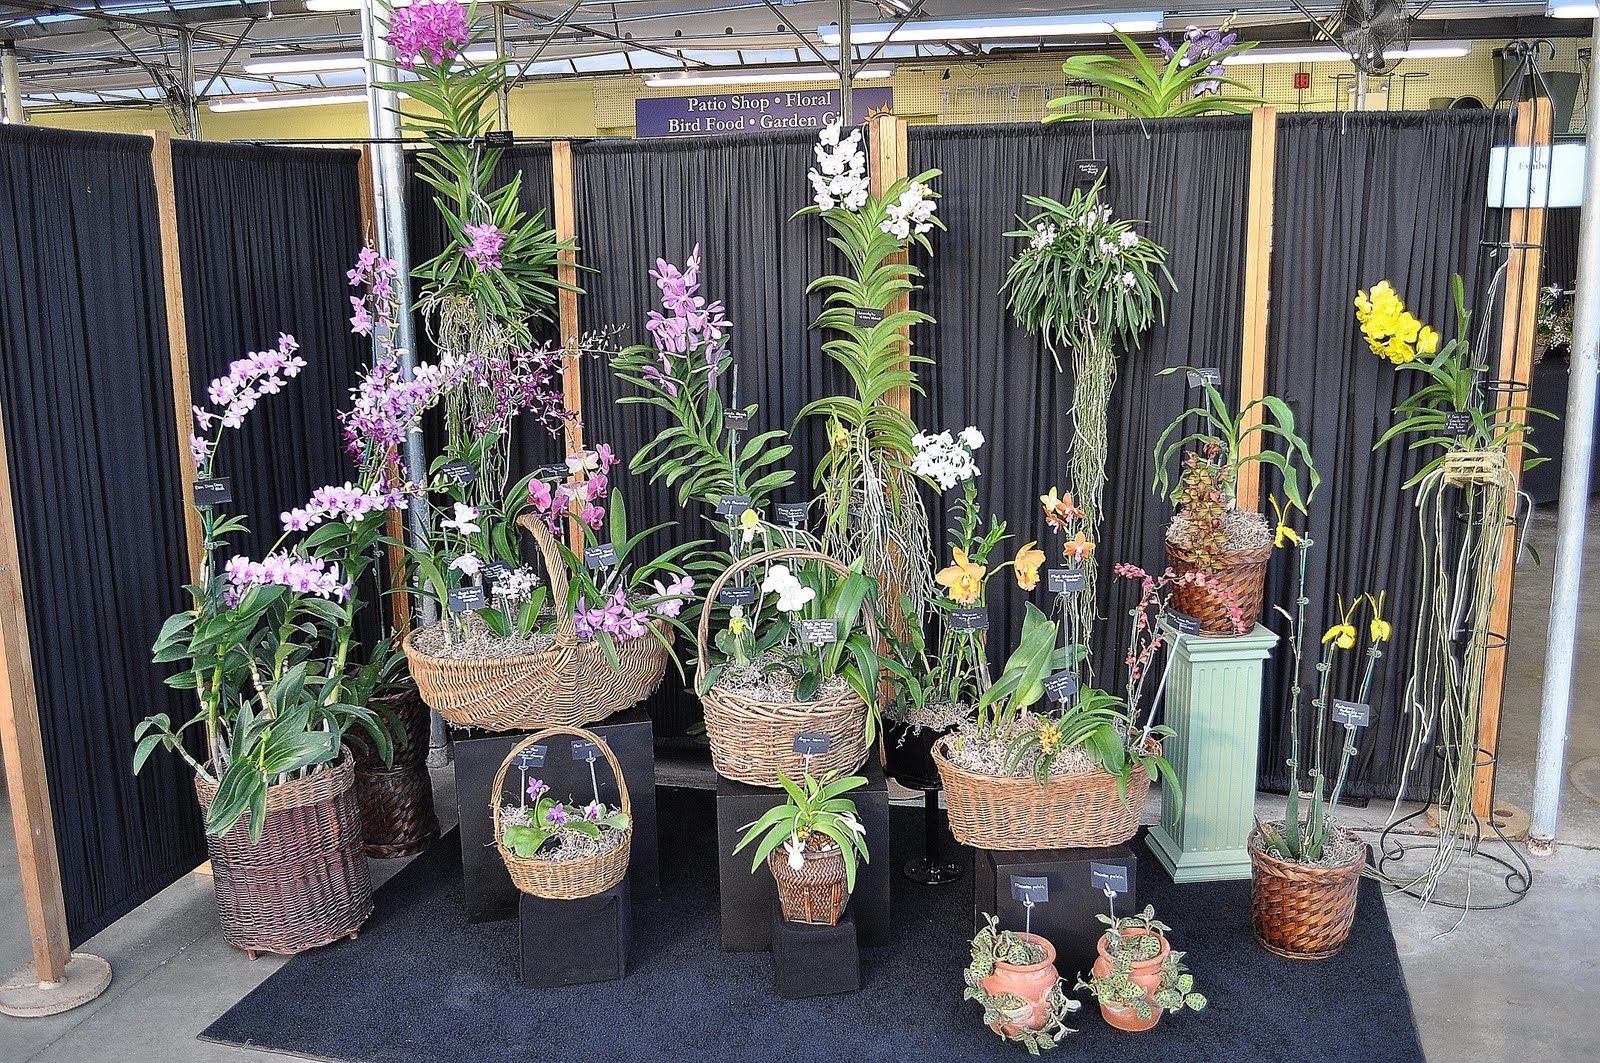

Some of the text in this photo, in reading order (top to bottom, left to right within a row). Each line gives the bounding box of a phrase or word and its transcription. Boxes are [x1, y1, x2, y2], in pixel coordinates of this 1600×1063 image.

[687, 91, 832, 113] Patio Shop Floral
[668, 117, 701, 133] Bird
[705, 115, 744, 131] Food
[759, 112, 817, 129] Garden
[1519, 161, 1548, 171] Exhibi
